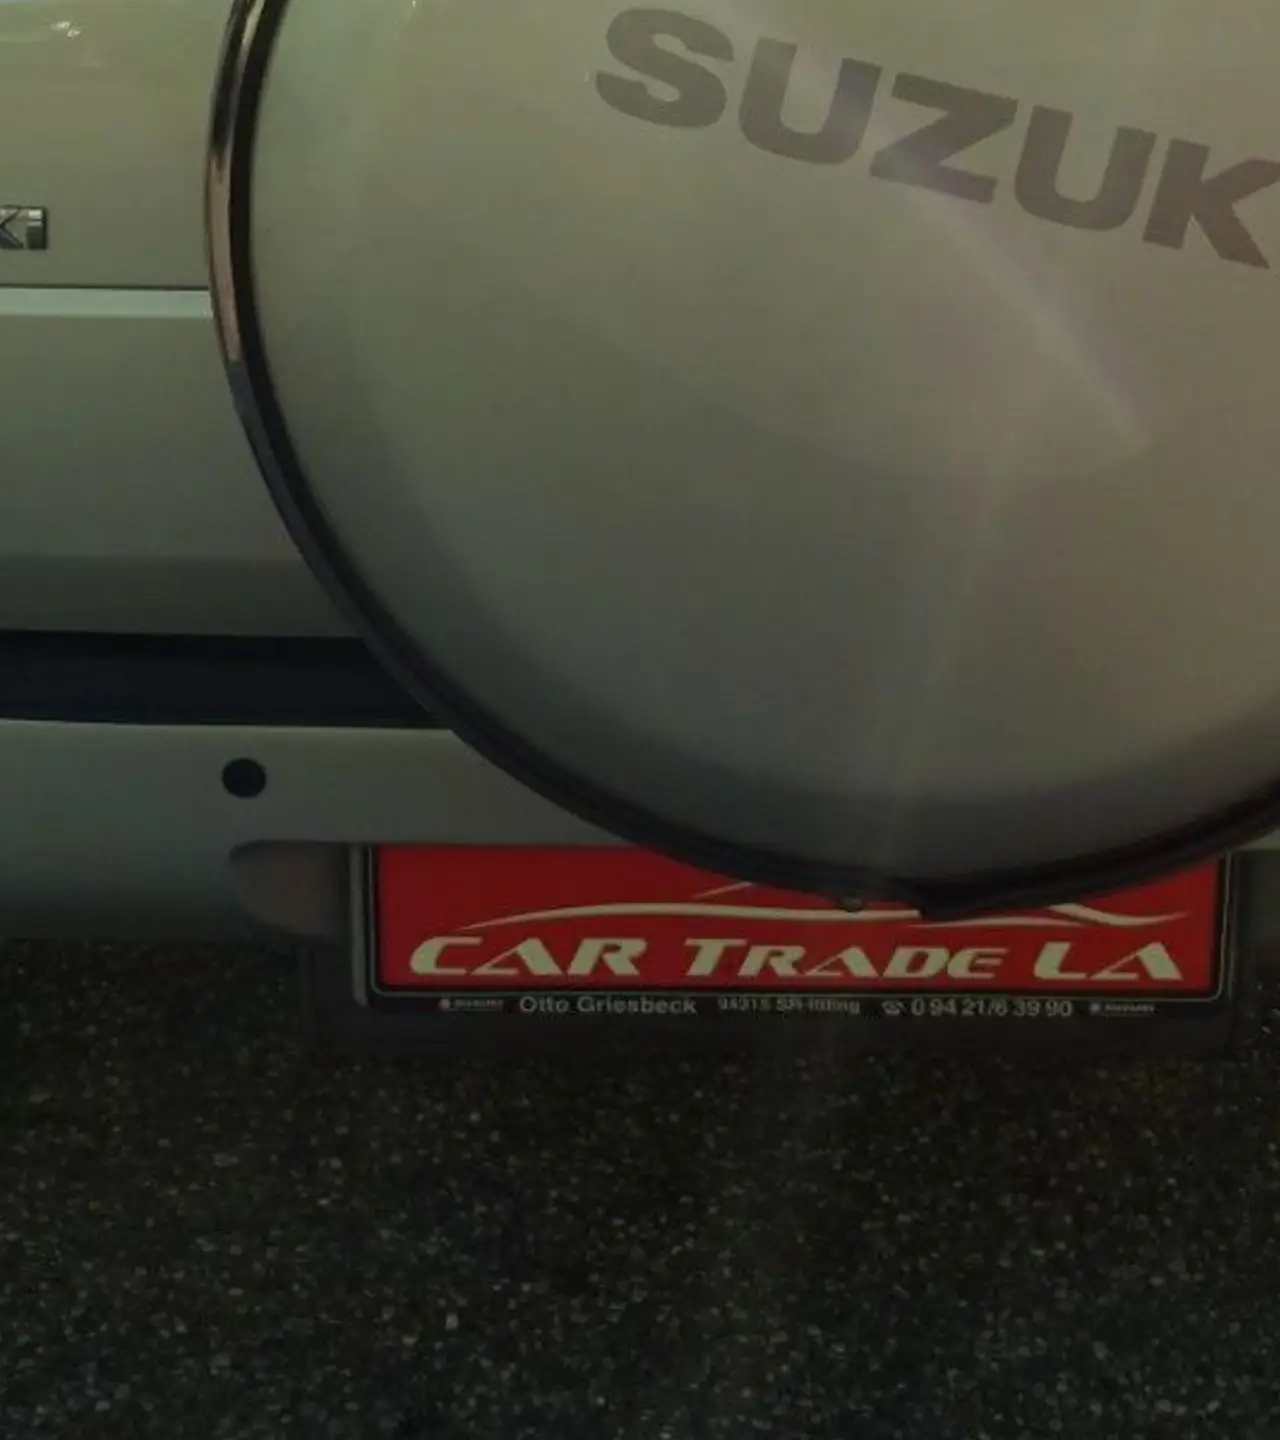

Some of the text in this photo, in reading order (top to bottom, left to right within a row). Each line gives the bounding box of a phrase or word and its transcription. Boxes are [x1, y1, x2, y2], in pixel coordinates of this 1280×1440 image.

[409, 936, 1183, 980] CAR TRADE LA
[519, 995, 570, 1012] Otto
[576, 996, 697, 1015] Griesbeck
